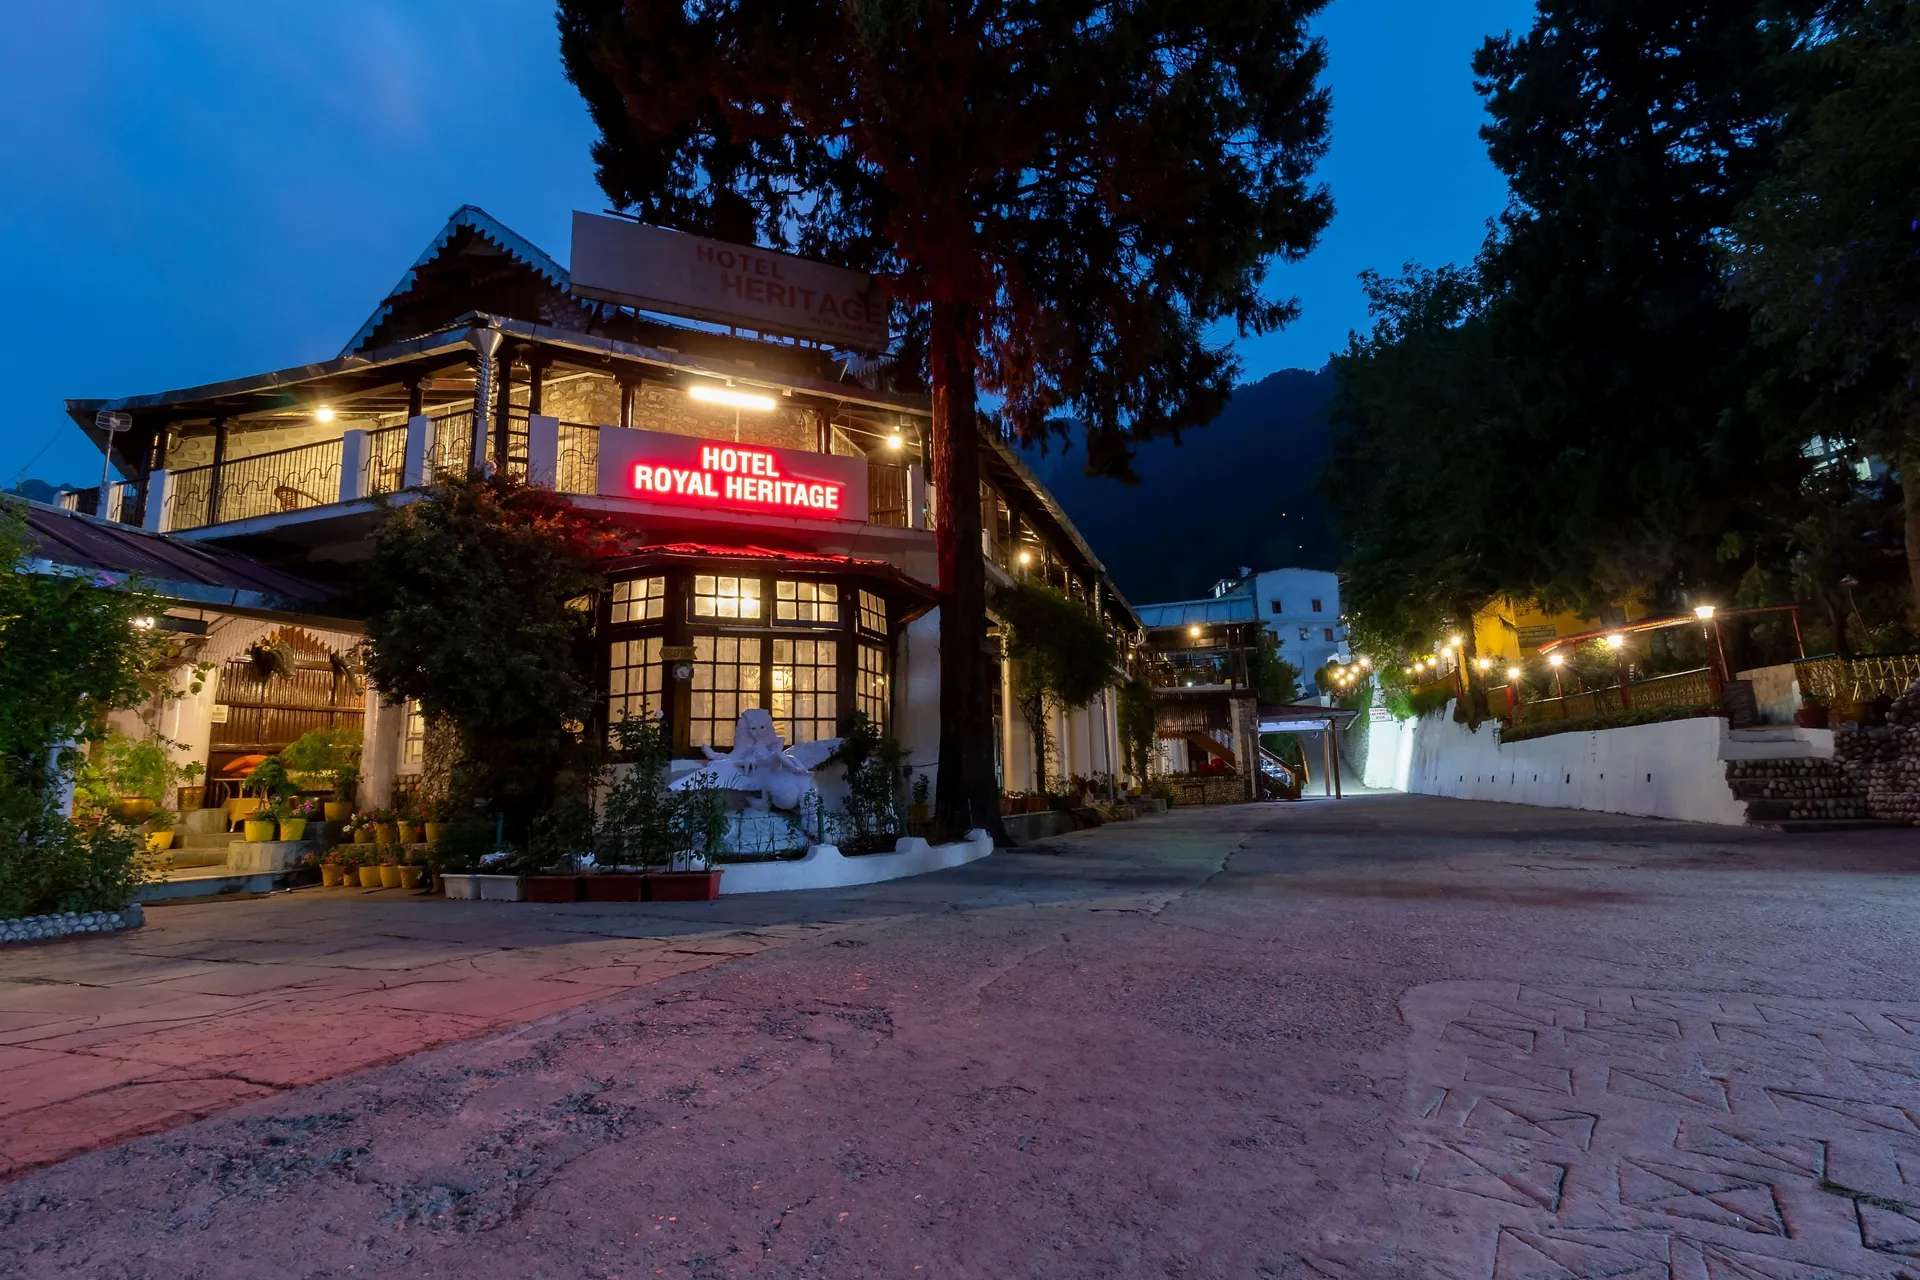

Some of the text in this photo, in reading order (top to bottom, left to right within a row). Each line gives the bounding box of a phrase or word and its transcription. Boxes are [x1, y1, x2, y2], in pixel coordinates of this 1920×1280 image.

[697, 244, 784, 279] HOTEL
[721, 272, 882, 325] HERITAGE
[703, 447, 779, 477] HOTEL
[635, 465, 839, 510] ROYAL HERITAGE
